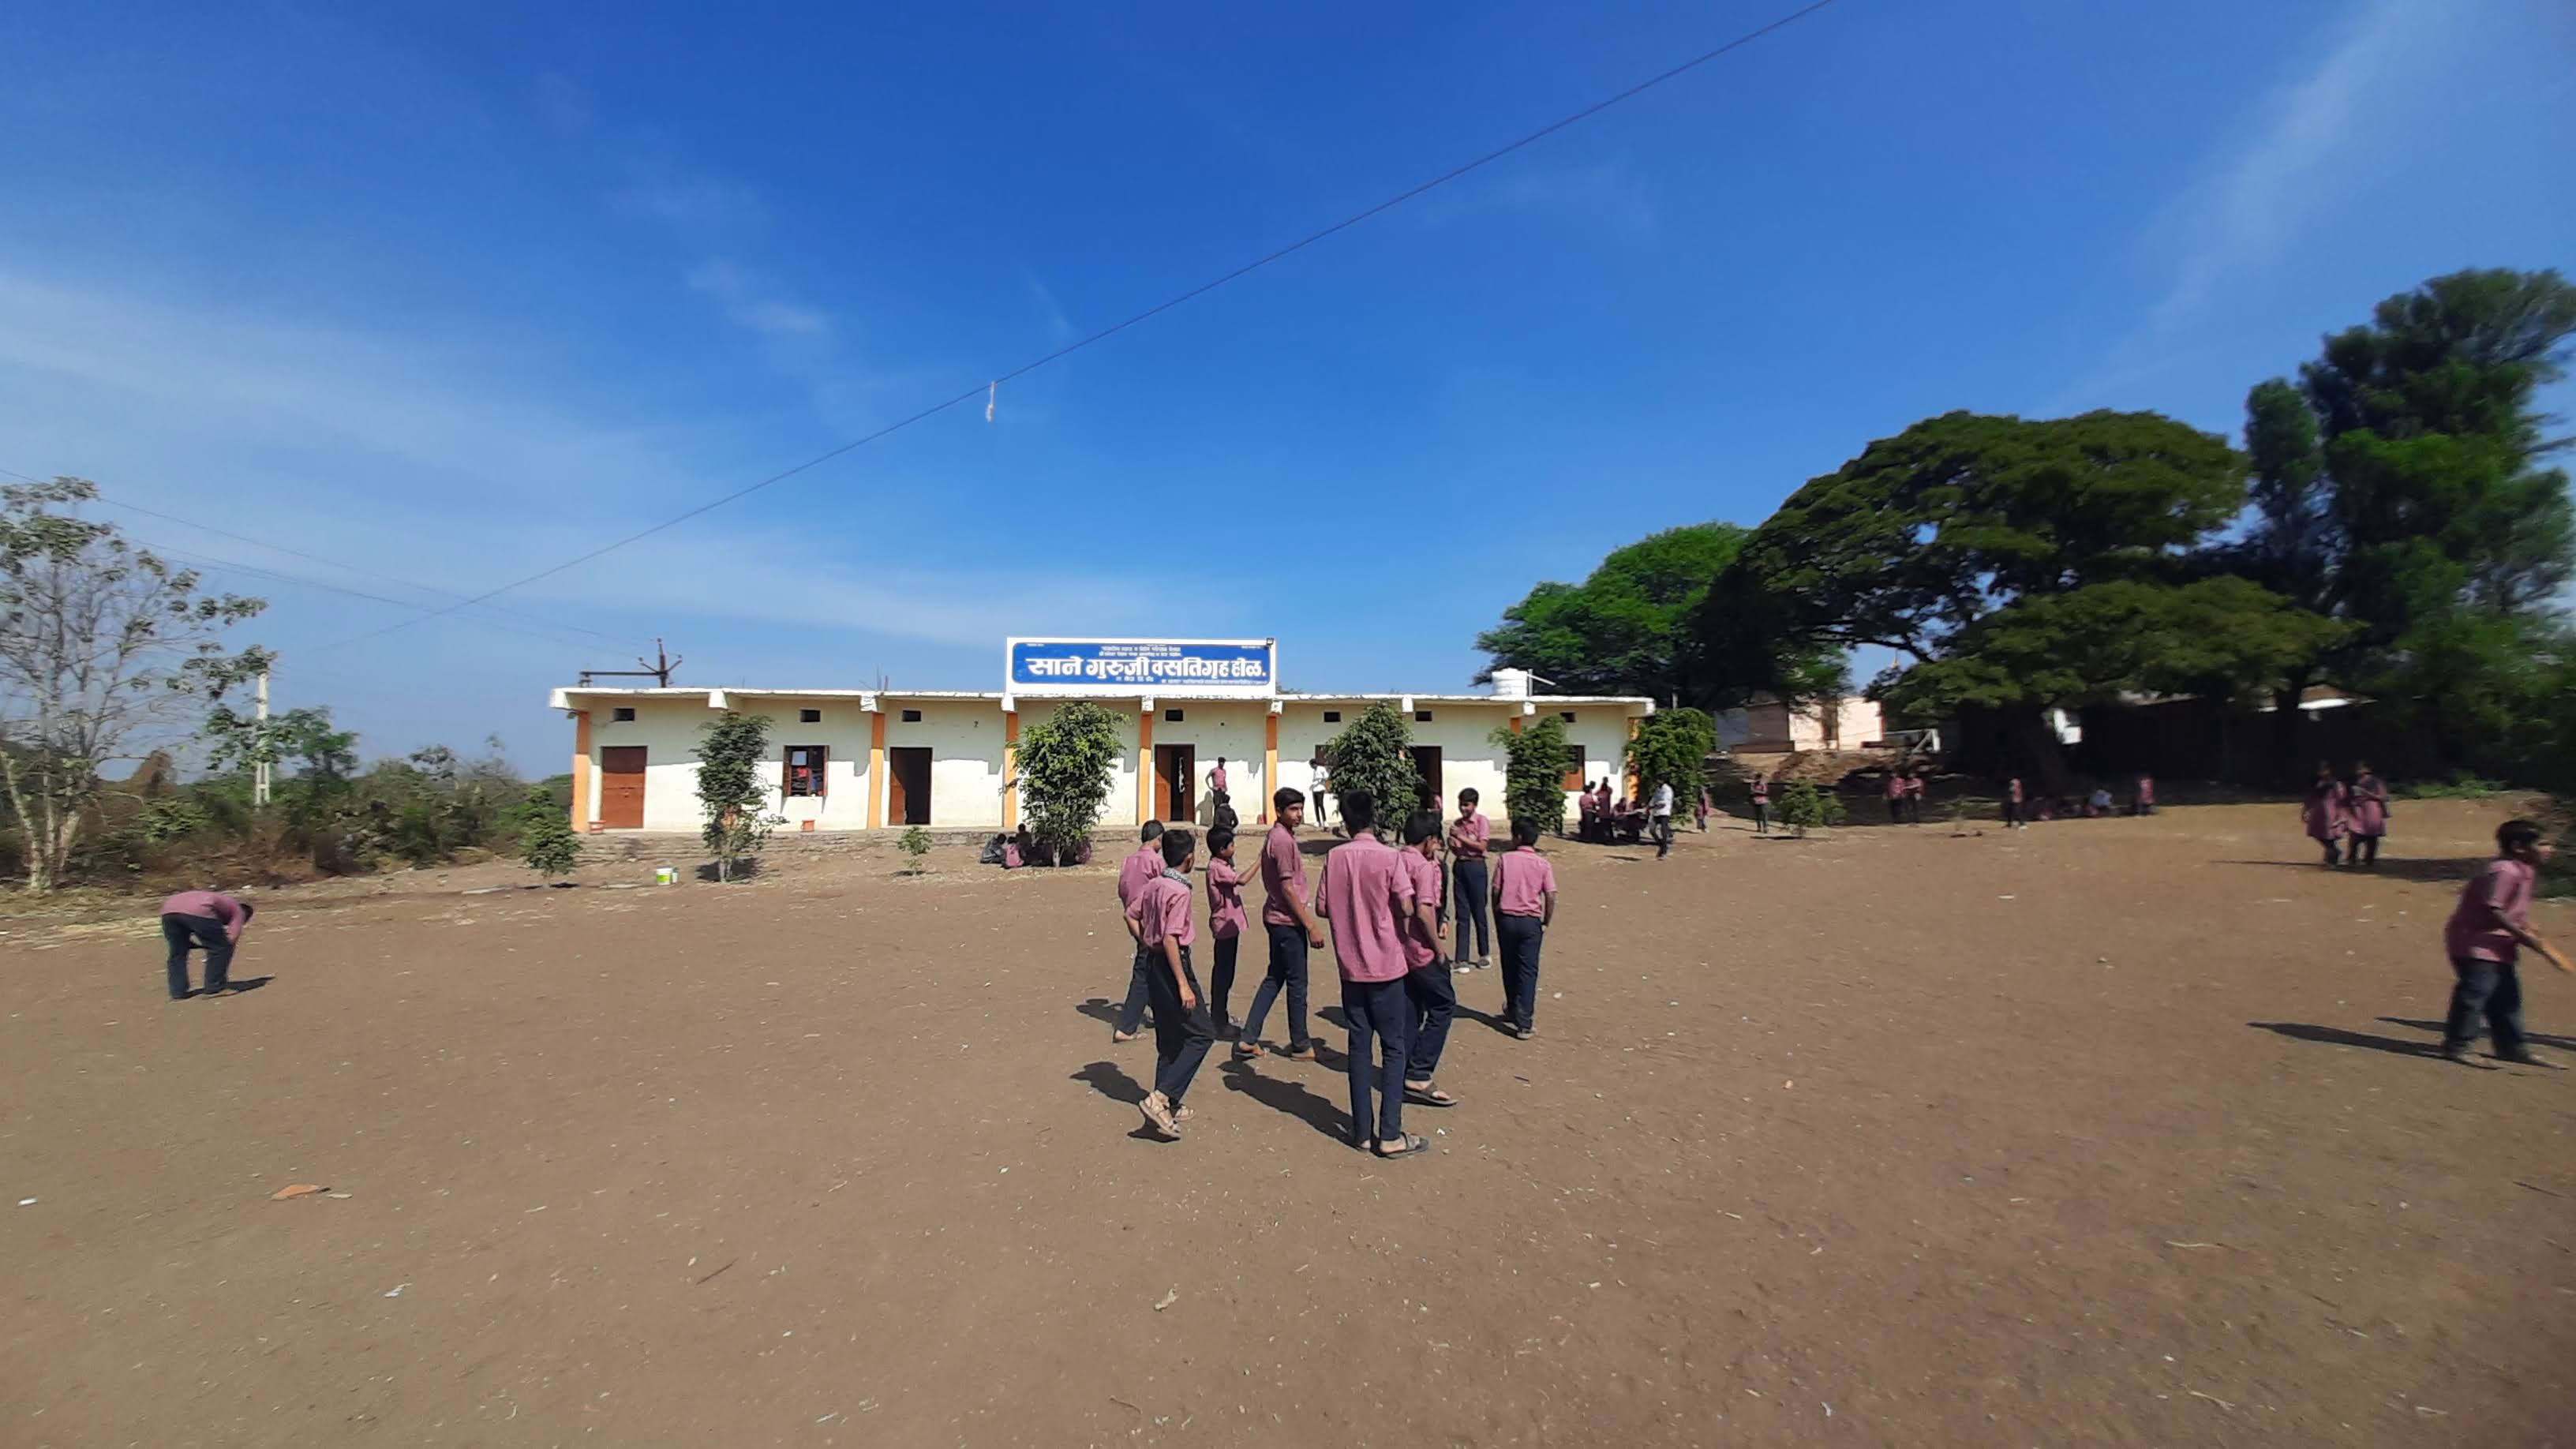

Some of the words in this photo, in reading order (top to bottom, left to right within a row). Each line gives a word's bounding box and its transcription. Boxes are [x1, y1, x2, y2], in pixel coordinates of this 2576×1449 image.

[1025, 656, 1084, 676] साने
[1085, 656, 1150, 679] गुरुजी
[1151, 657, 1230, 680] वसतिगृह
